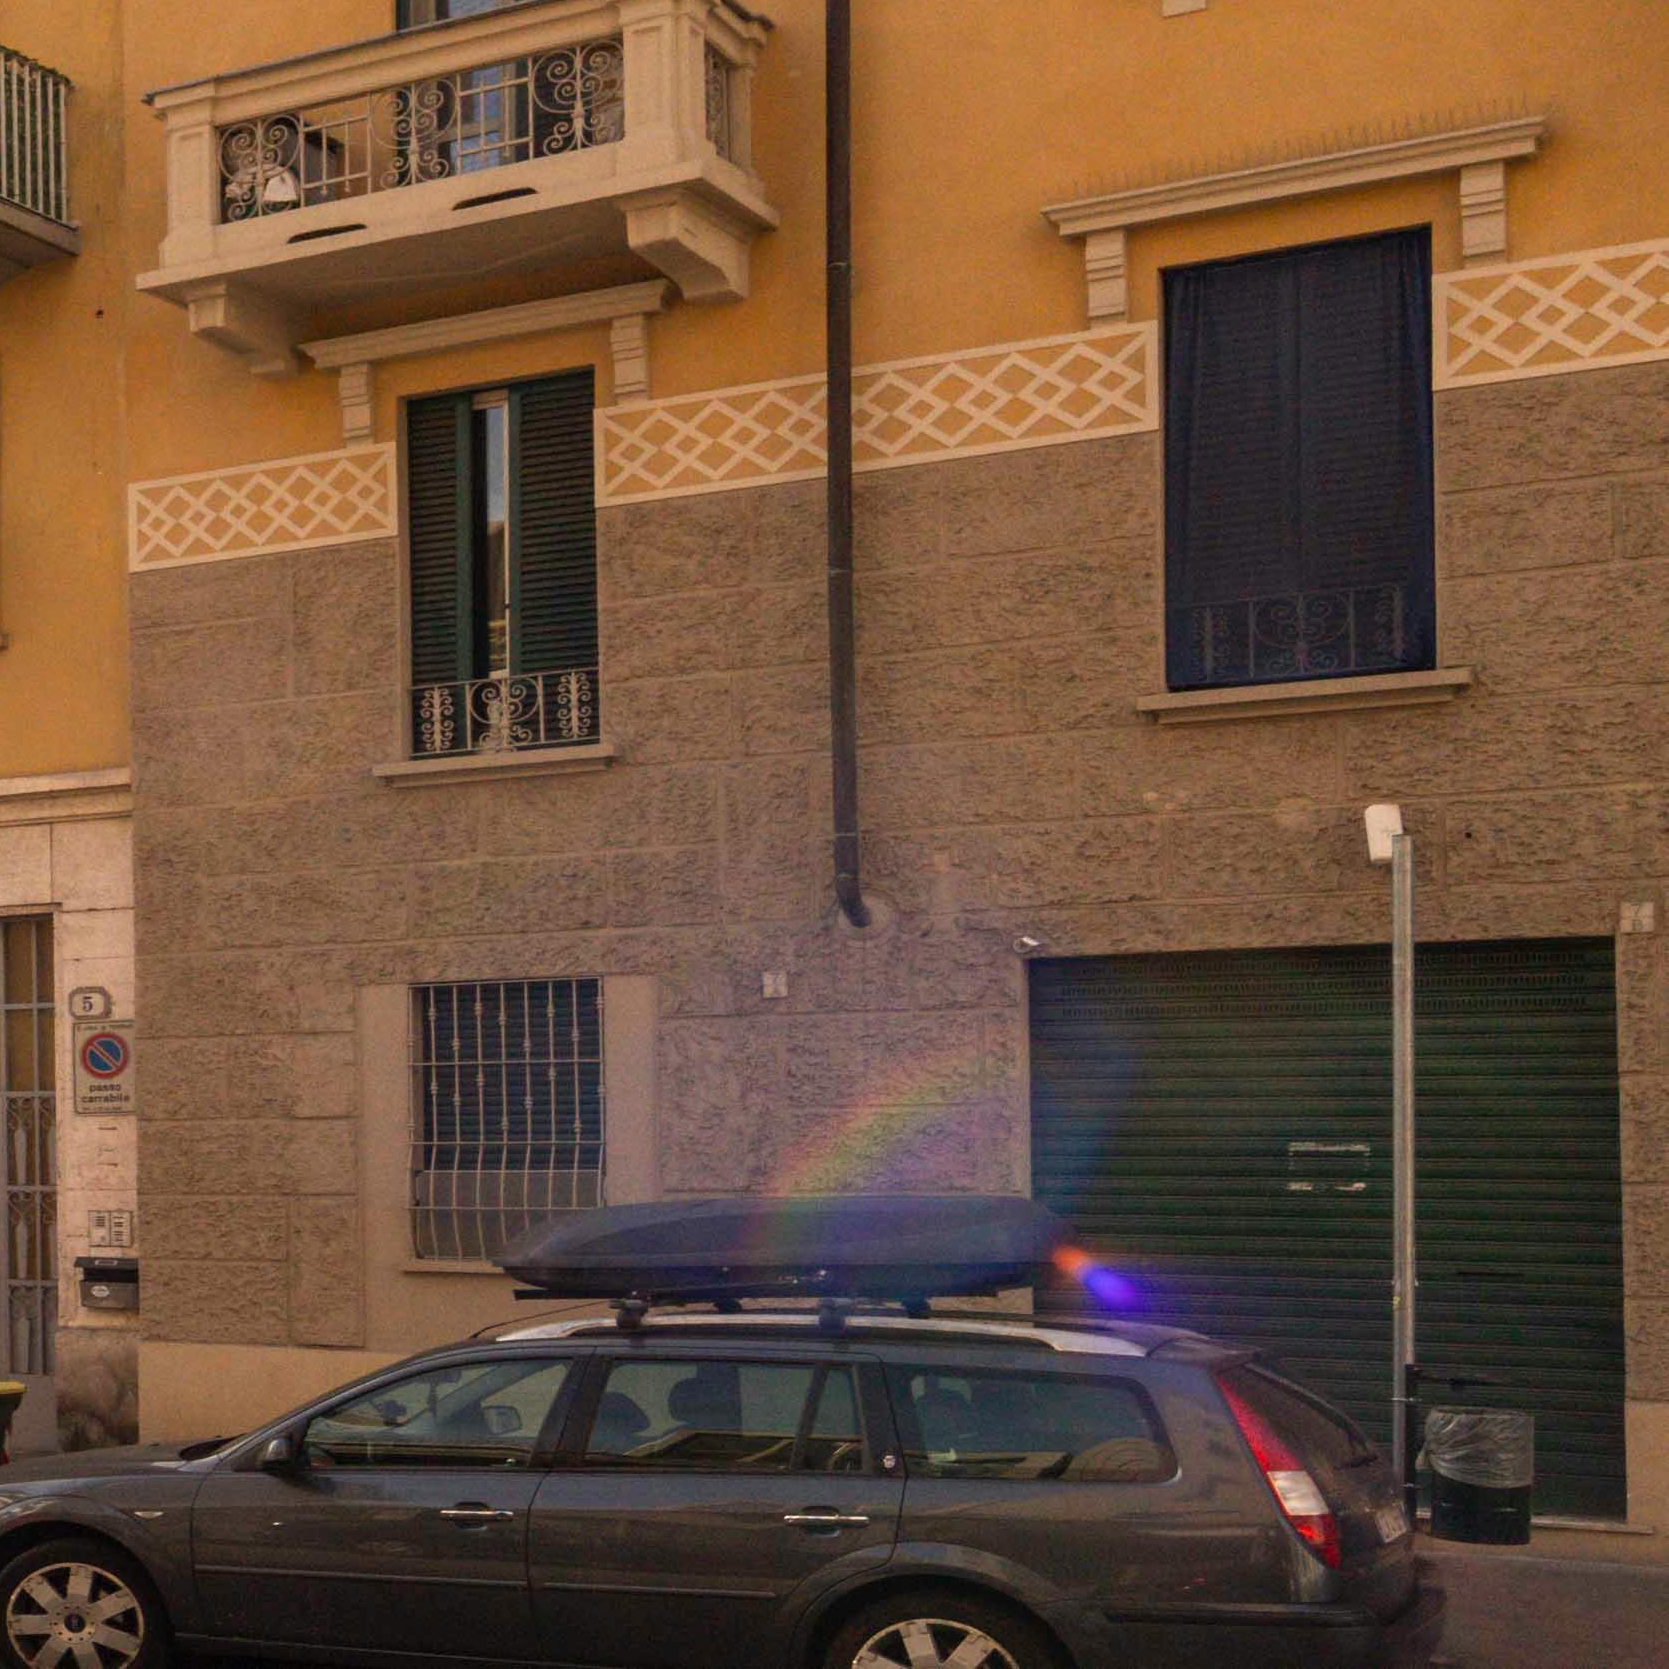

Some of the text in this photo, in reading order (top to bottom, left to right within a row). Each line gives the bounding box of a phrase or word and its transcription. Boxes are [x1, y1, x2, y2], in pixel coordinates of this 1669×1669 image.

[83, 996, 93, 1011] 5
[89, 1084, 121, 1093] passo
[81, 1094, 130, 1103] carrabile
